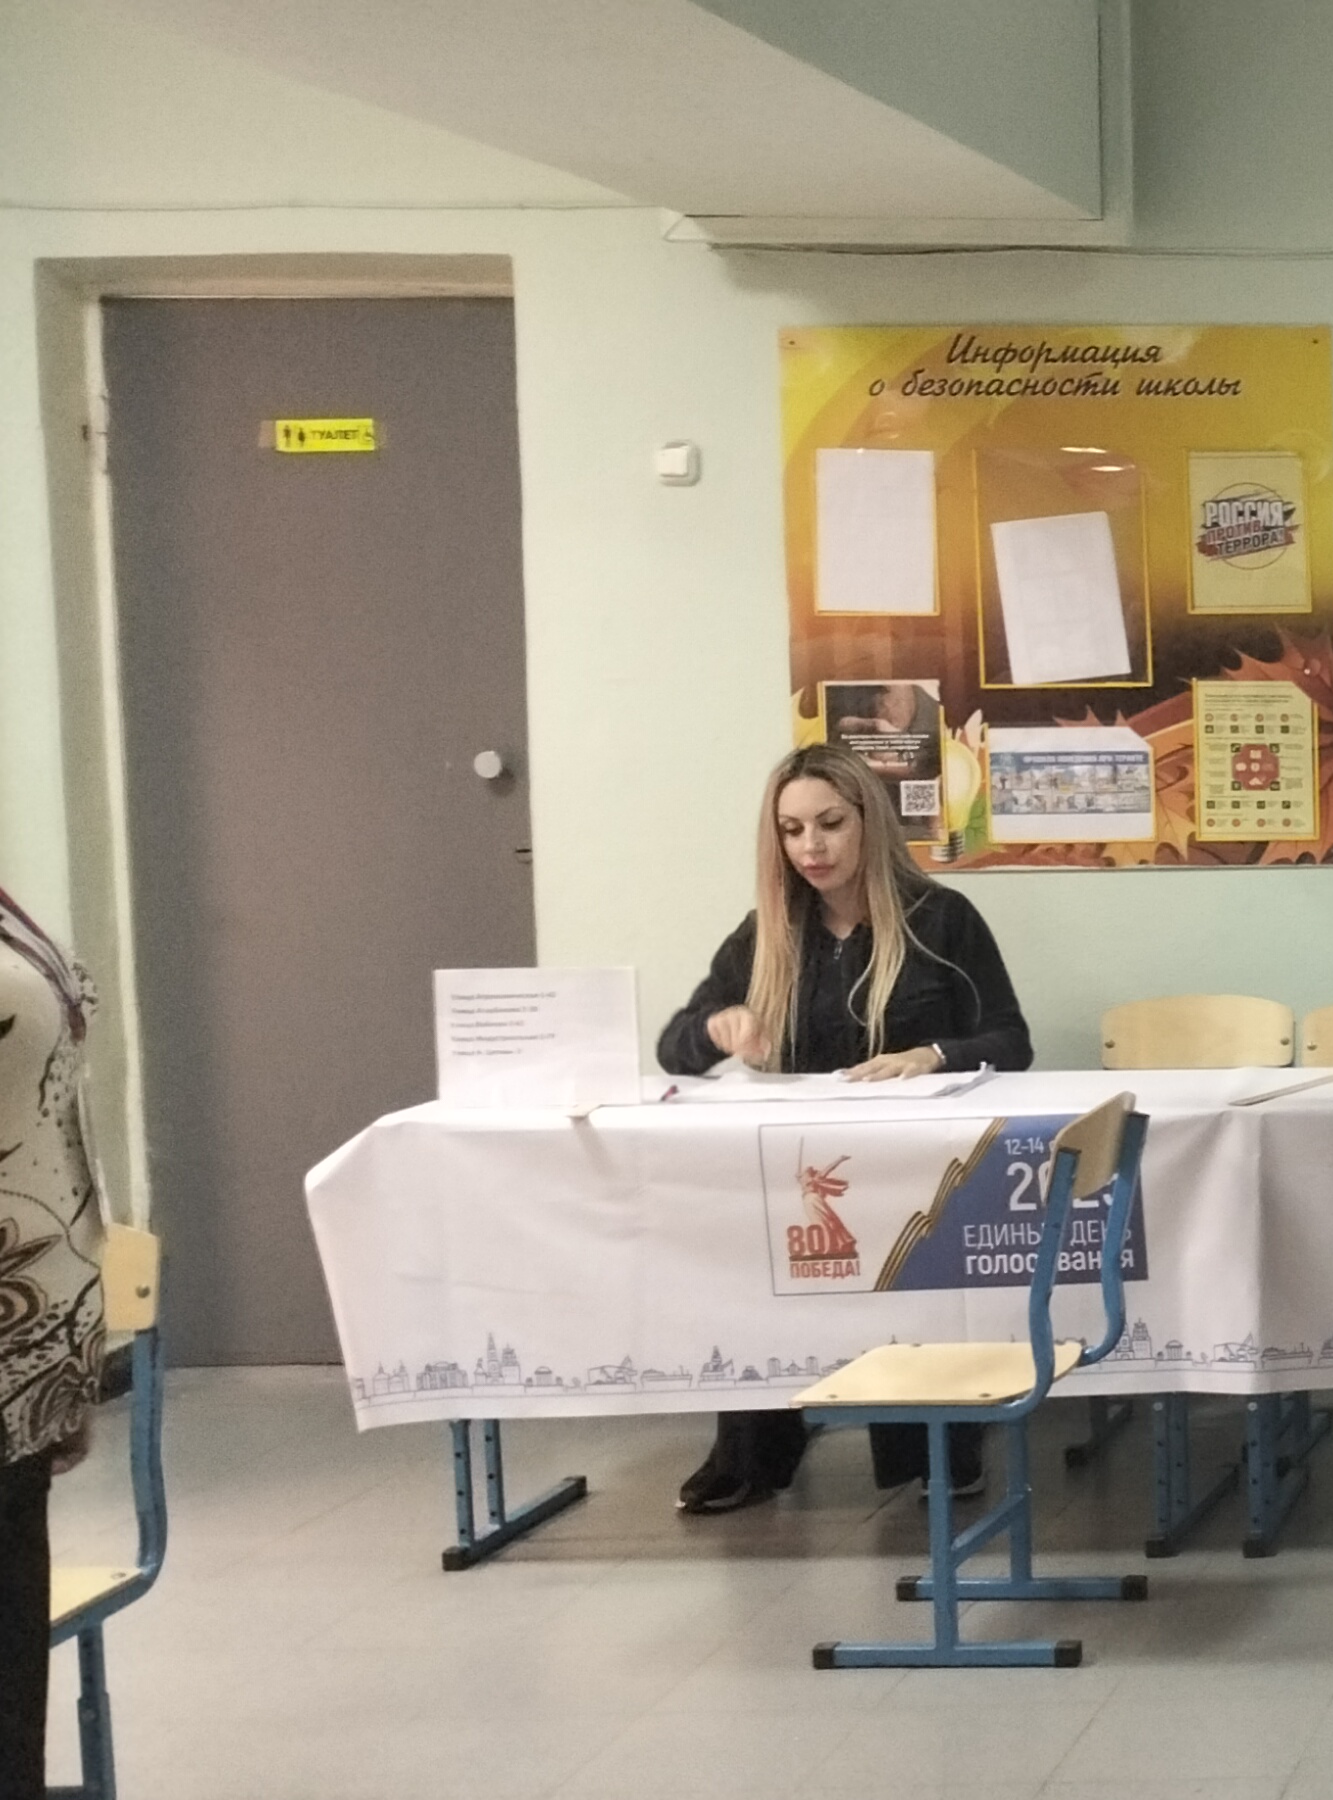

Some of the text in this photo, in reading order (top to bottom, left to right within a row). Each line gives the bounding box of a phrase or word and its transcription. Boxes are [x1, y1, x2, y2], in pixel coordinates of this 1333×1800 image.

[948, 333, 1163, 373] Информация
[869, 368, 1242, 397] о безопасности школы
[1205, 501, 1284, 528] РОССИЯ
[1206, 519, 1262, 544] ПРОТИВ
[1004, 1137, 1044, 1155] 12-14
[787, 1224, 824, 1256] 80
[963, 1222, 1046, 1250] ЕДИНЫ
[790, 1260, 861, 1280] ПОБЕДА!
[965, 1249, 1135, 1276] голосваня
